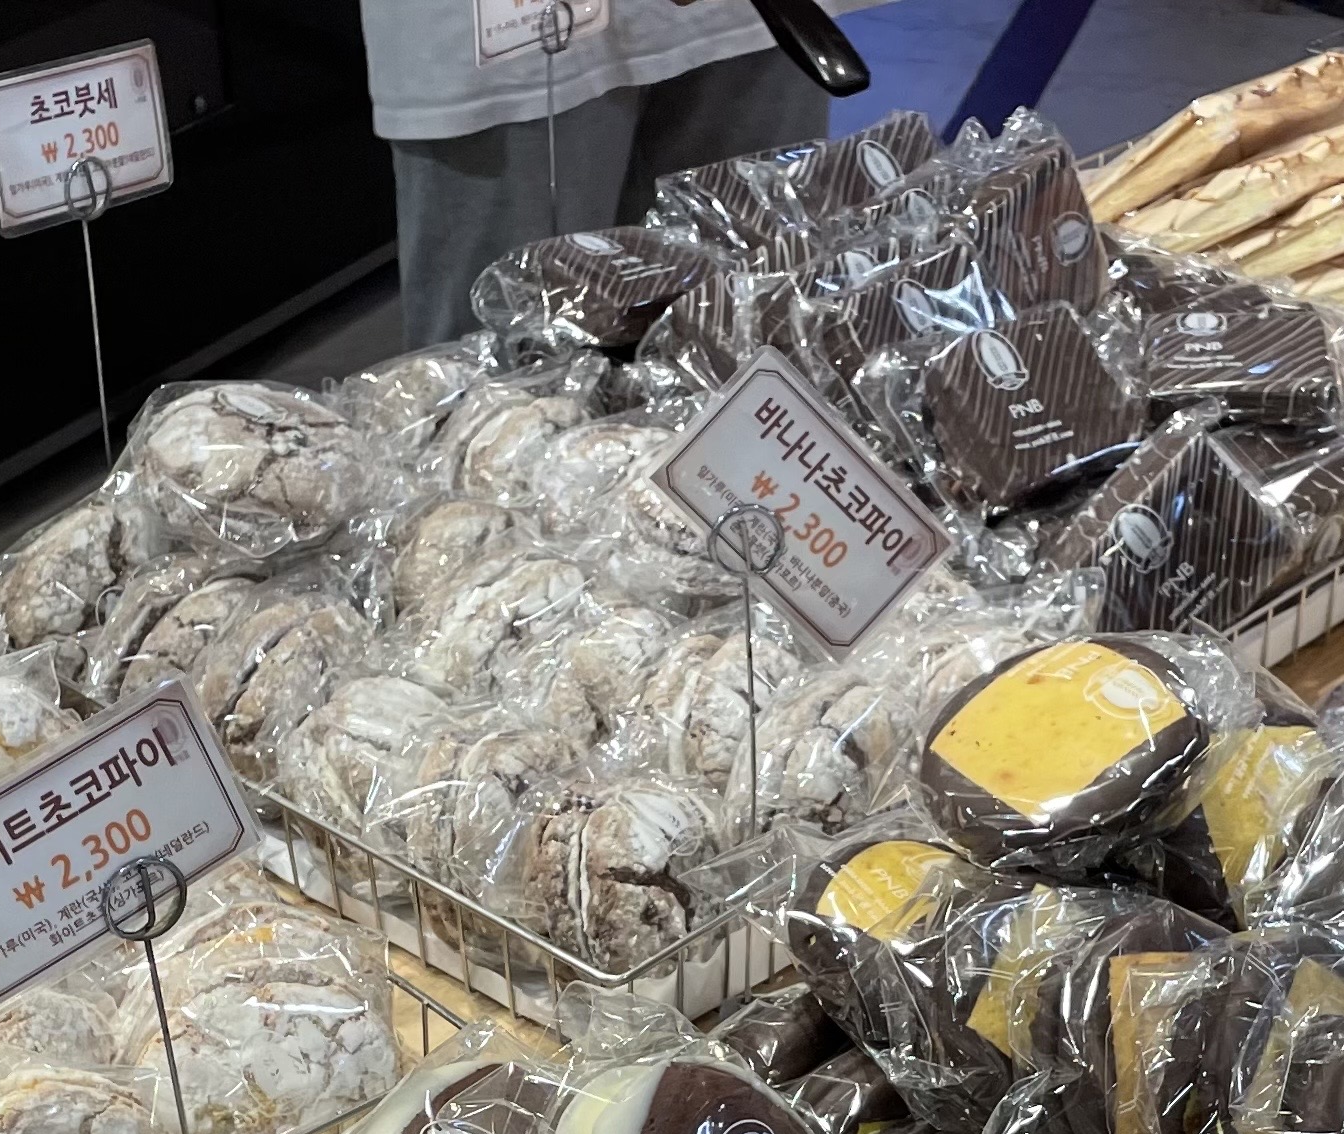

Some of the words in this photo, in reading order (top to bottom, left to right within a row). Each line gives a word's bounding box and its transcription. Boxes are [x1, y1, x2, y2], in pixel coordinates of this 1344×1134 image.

[30, 77, 119, 125] 초코붓세
[64, 121, 120, 159] 2,300
[754, 397, 914, 567] 바나나초코파이
[774, 492, 849, 569] 2,300
[50, 808, 153, 890] 2,300
